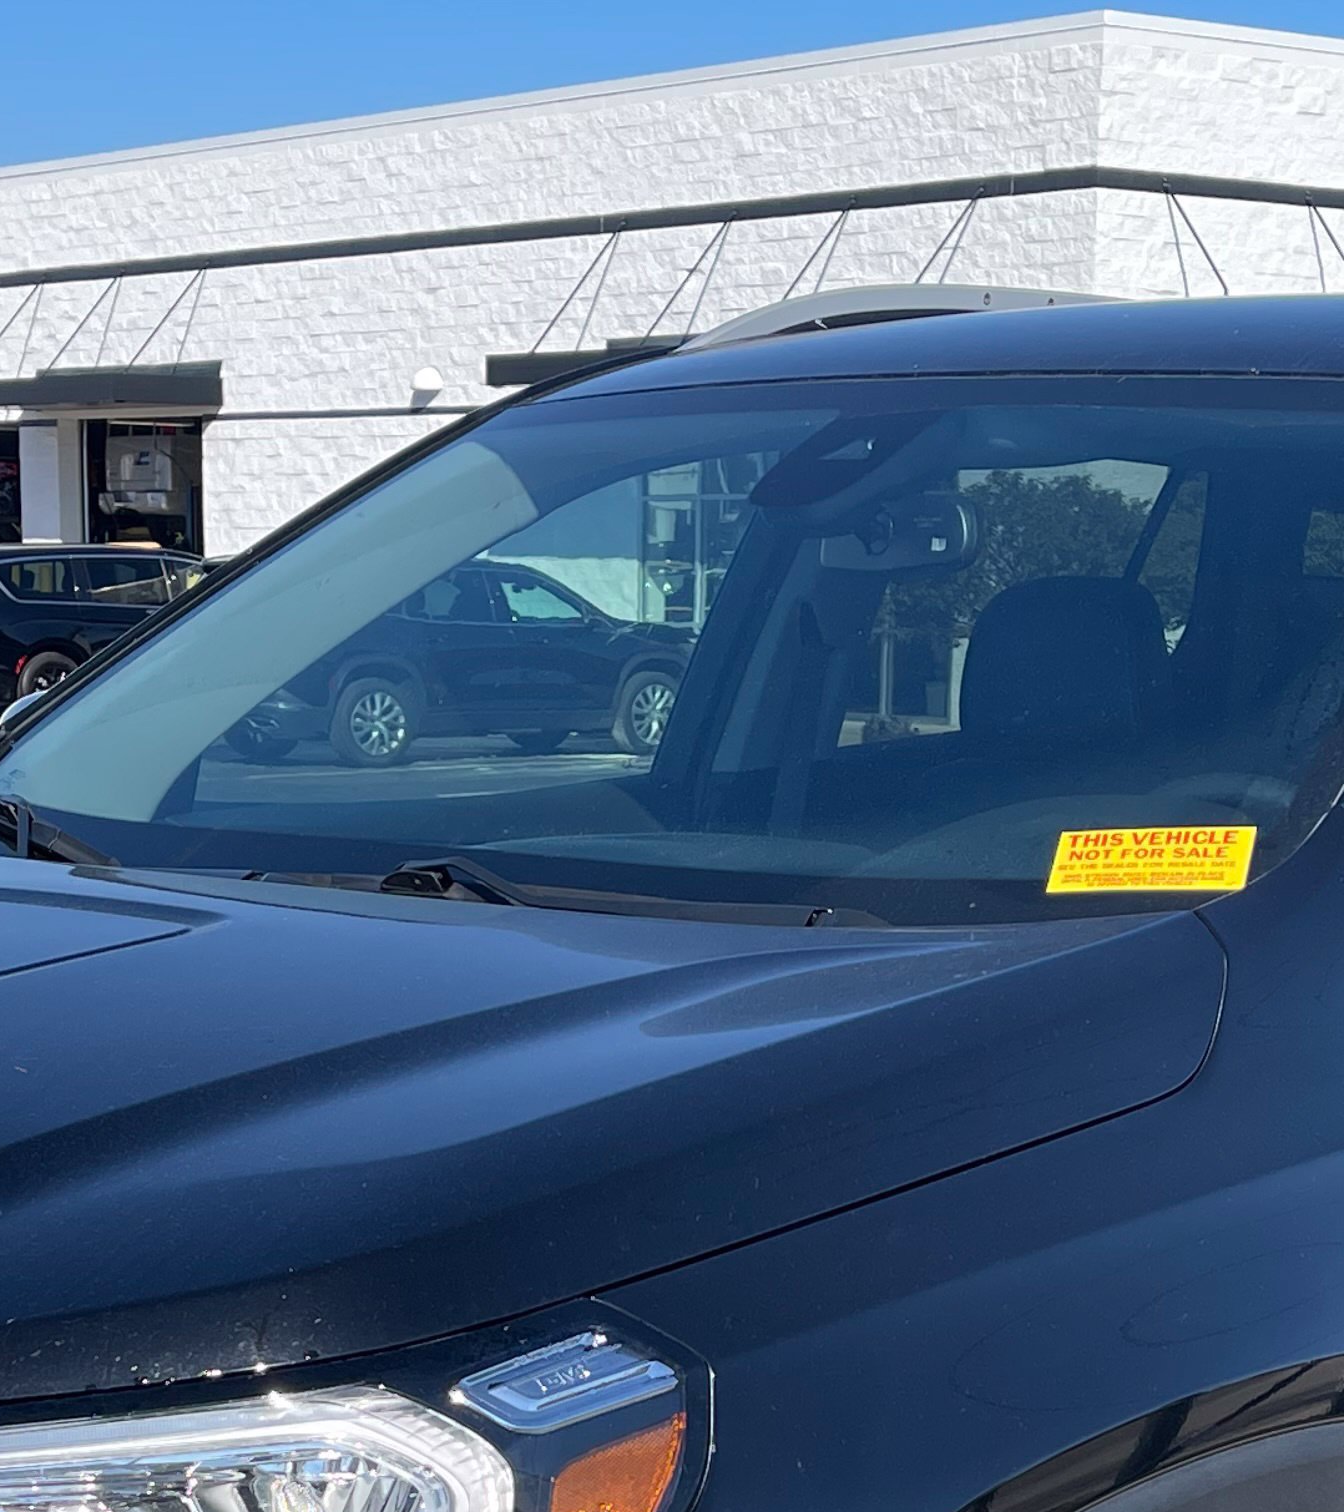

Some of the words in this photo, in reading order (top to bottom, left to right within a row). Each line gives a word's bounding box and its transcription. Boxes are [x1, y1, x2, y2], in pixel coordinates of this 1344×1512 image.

[1068, 833, 1124, 849] THIS
[1132, 830, 1239, 847] VEHICLE
[1068, 848, 1111, 861] NOT
[1120, 847, 1164, 860] FOR
[1173, 846, 1229, 859] SALE
